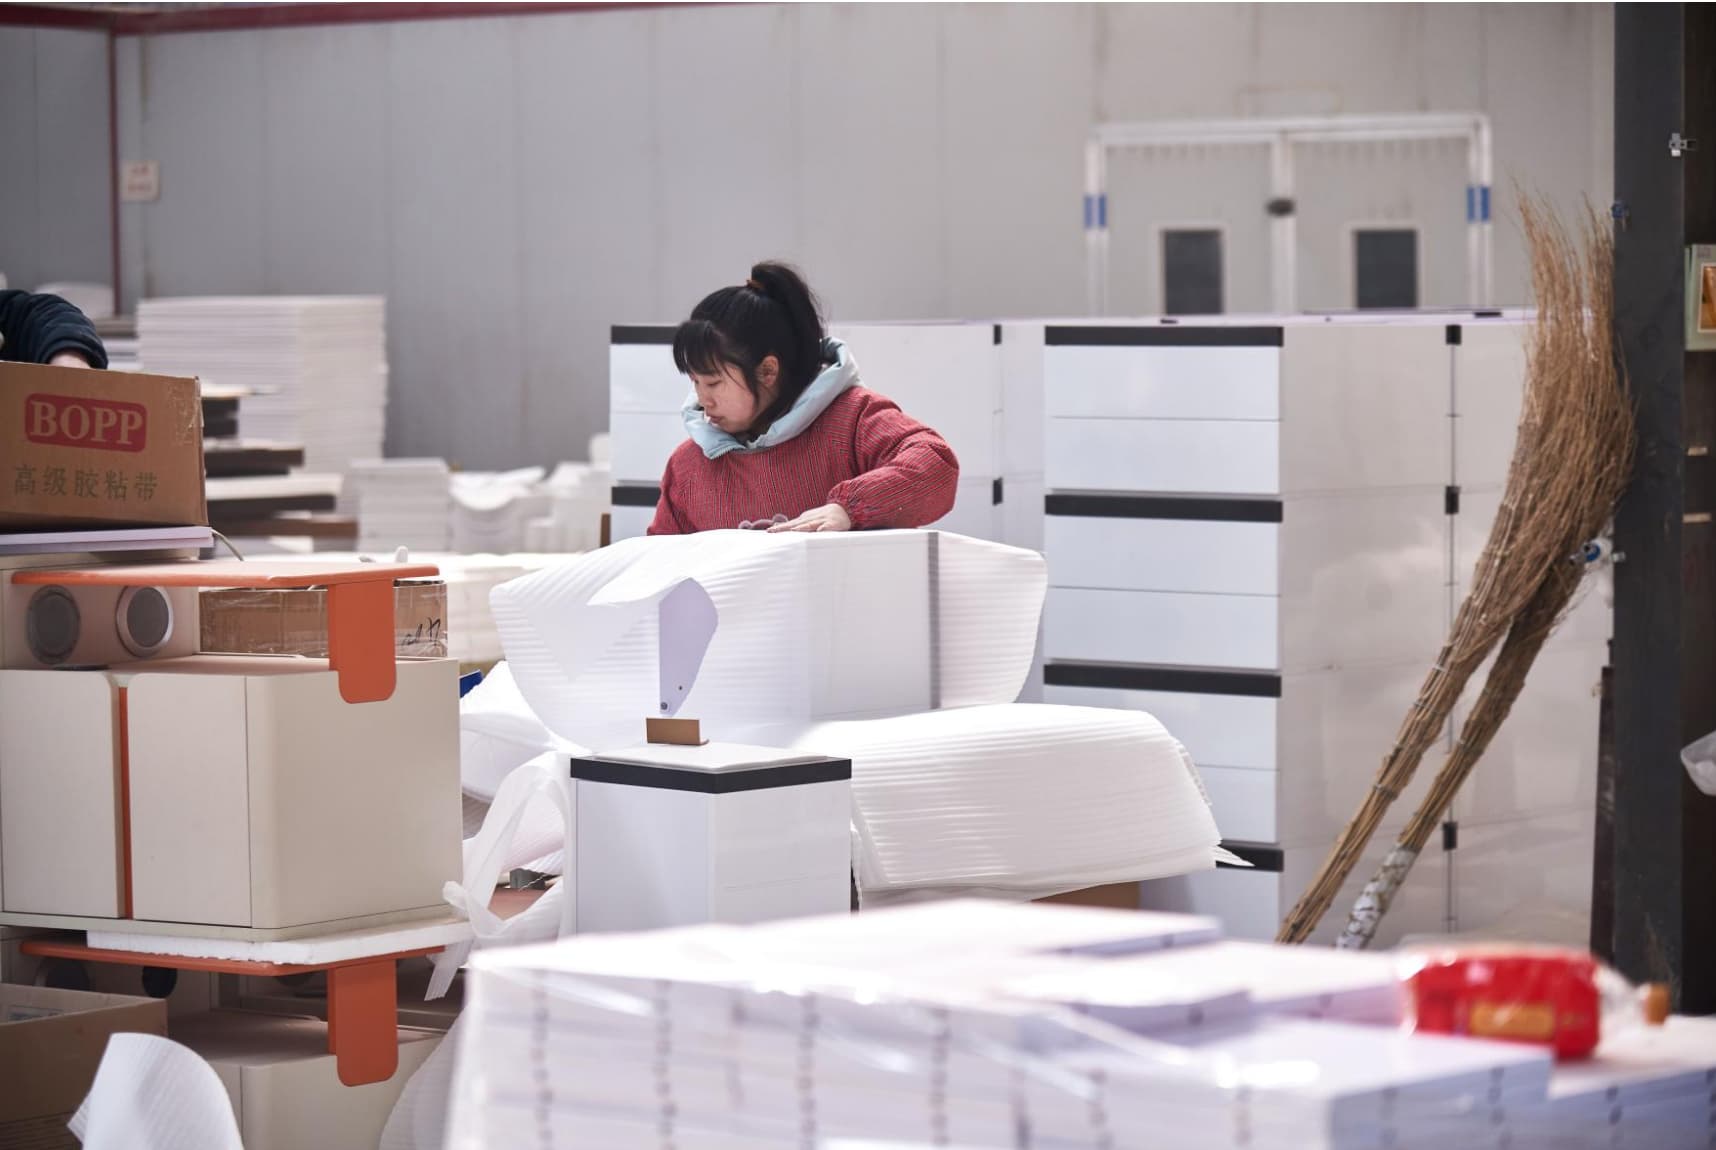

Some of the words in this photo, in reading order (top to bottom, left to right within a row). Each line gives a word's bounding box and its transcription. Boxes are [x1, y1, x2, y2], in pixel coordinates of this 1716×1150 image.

[30, 401, 143, 445] BOPP
[14, 464, 160, 501] 高级胶粘带
